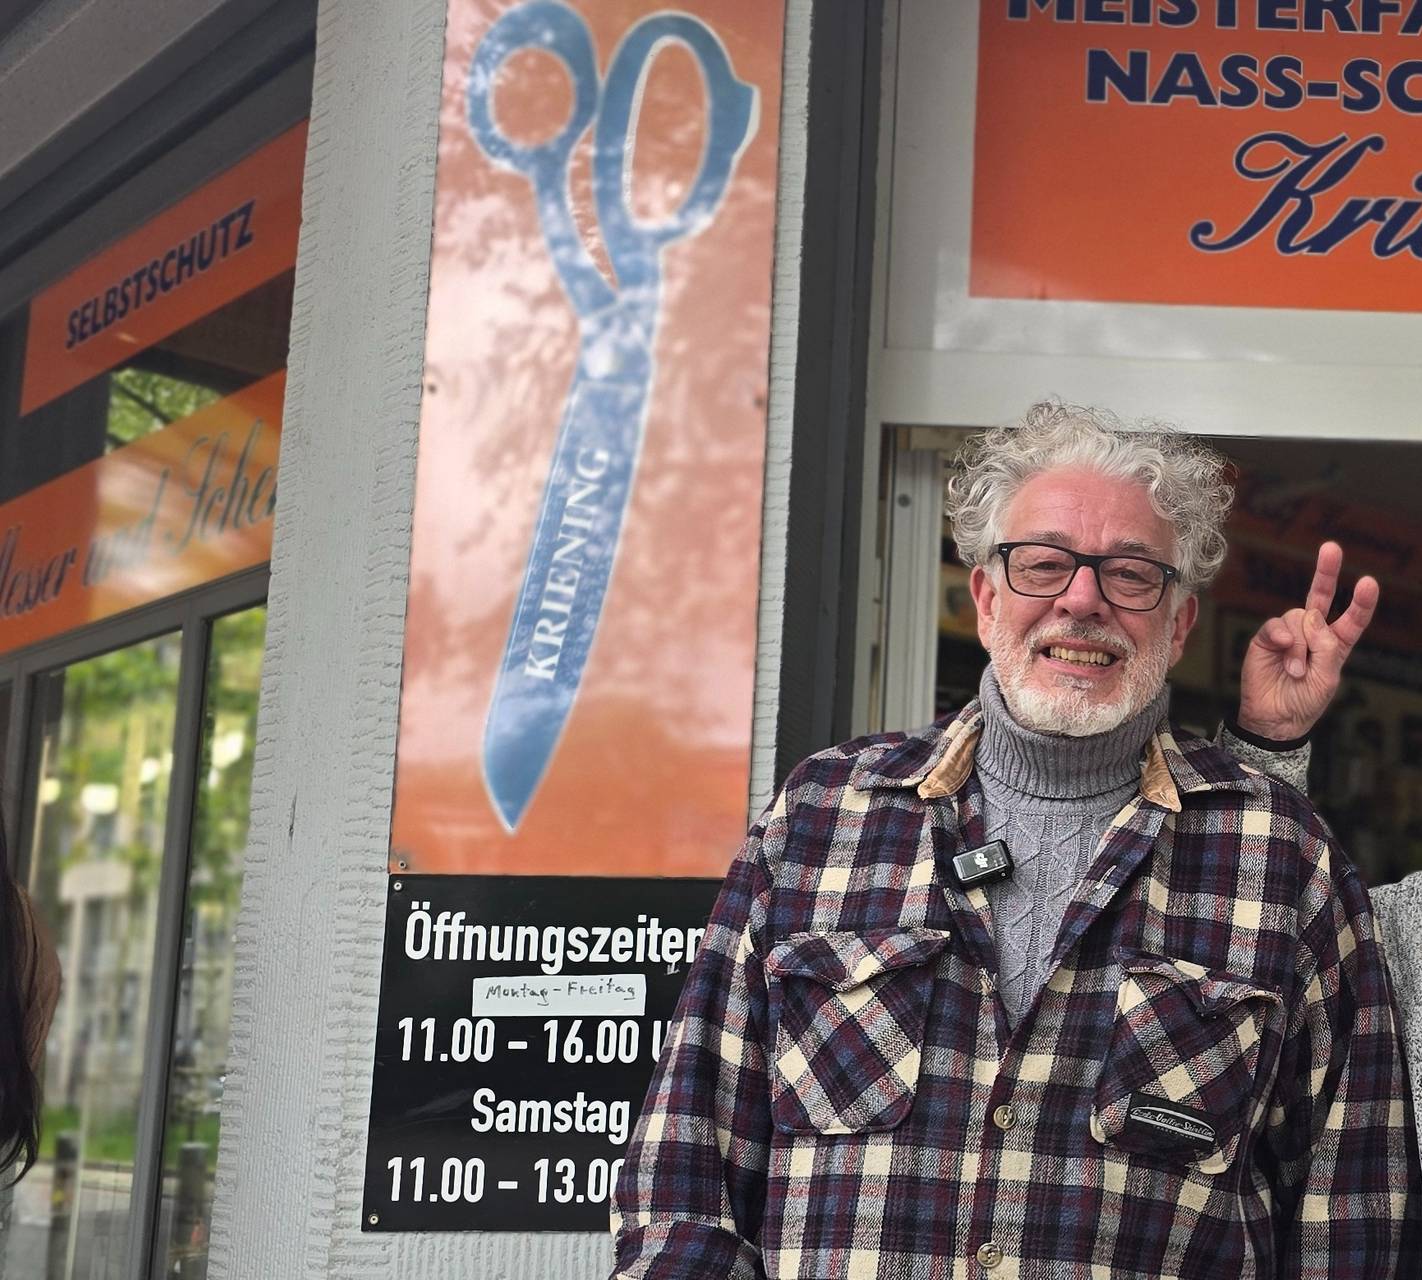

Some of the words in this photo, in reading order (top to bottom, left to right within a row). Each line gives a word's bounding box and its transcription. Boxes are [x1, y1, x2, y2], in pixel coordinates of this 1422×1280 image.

[66, 200, 255, 349] SELBSTSCHUTZ
[0, 525, 77, 618] esser
[523, 447, 609, 681] KRIENING
[486, 983, 549, 1006] Montag
[568, 978, 636, 1000] Freitag
[398, 1017, 496, 1063] 11.00
[544, 1019, 639, 1063] 16.00
[471, 1088, 630, 1145] Samstag
[387, 1157, 485, 1202] 11.00
